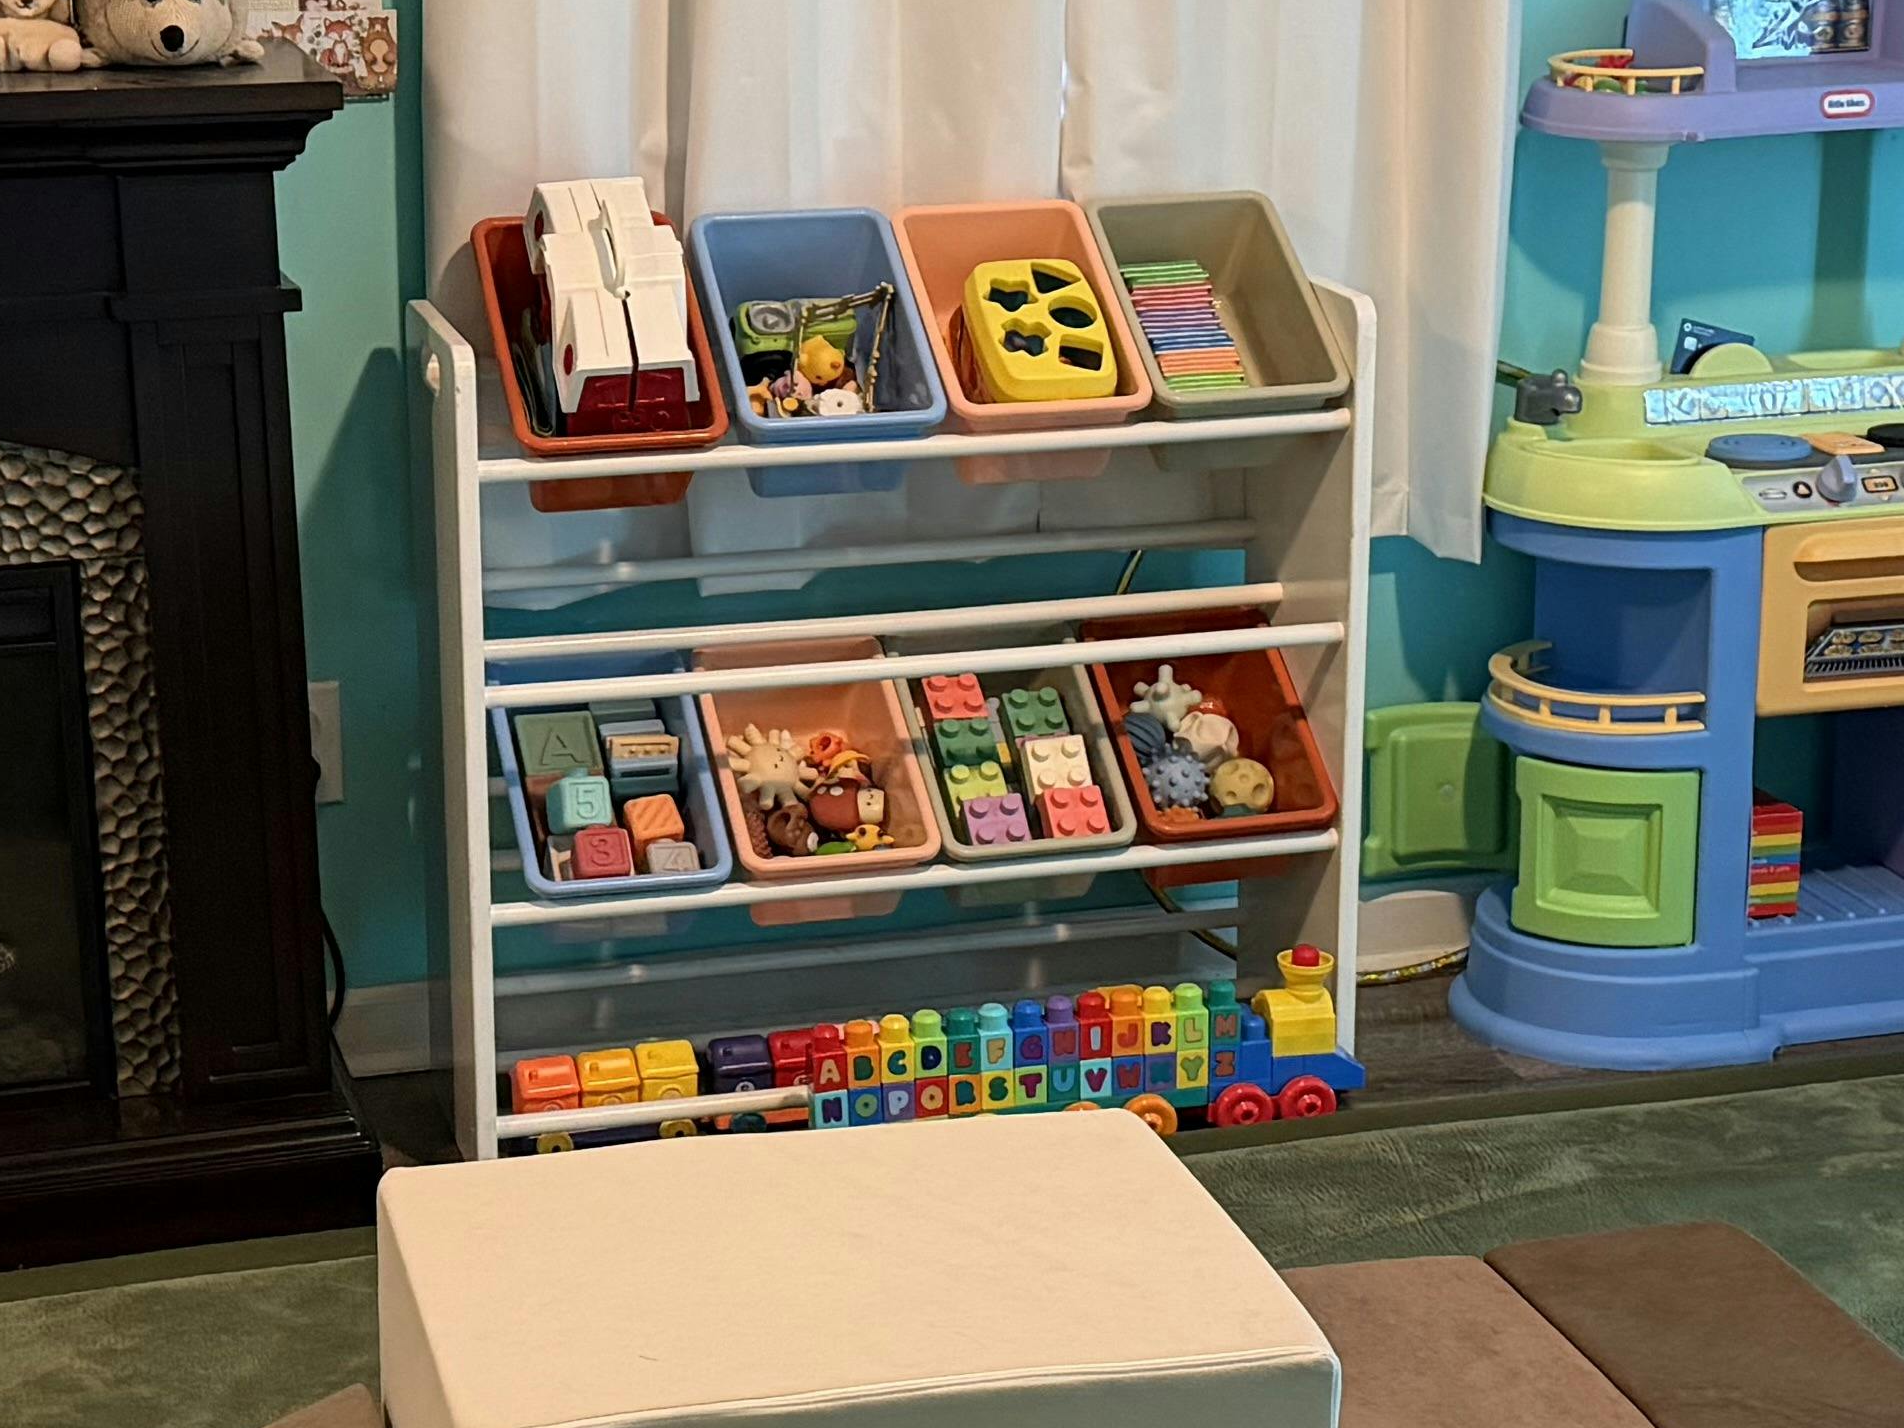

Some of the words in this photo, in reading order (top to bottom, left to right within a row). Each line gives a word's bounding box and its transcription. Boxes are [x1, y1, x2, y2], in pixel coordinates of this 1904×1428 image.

[541, 727, 587, 766] A
[576, 788, 598, 820] 5
[662, 850, 689, 871] 4
[820, 1059, 840, 1084] A
[853, 1055, 874, 1081] B
[887, 1050, 907, 1075] C
[921, 1045, 942, 1070] D
[954, 1042, 973, 1068] E
[986, 1037, 1005, 1064] F
[1020, 1035, 1043, 1060] G
[1117, 1022, 1138, 1048] J
[1151, 1021, 1171, 1046] K
[1184, 1017, 1203, 1043] L
[1215, 1014, 1237, 1038] M
[822, 1096, 843, 1123] N
[854, 1093, 877, 1117] O
[888, 1090, 909, 1115] P
[988, 1076, 1008, 1101] S
[1019, 1073, 1042, 1098] T
[1052, 1068, 1075, 1092] U
[1084, 1068, 1107, 1092] V
[1116, 1063, 1141, 1089] W
[1180, 1055, 1204, 1081] Y
[1215, 1051, 1235, 1077] Z
